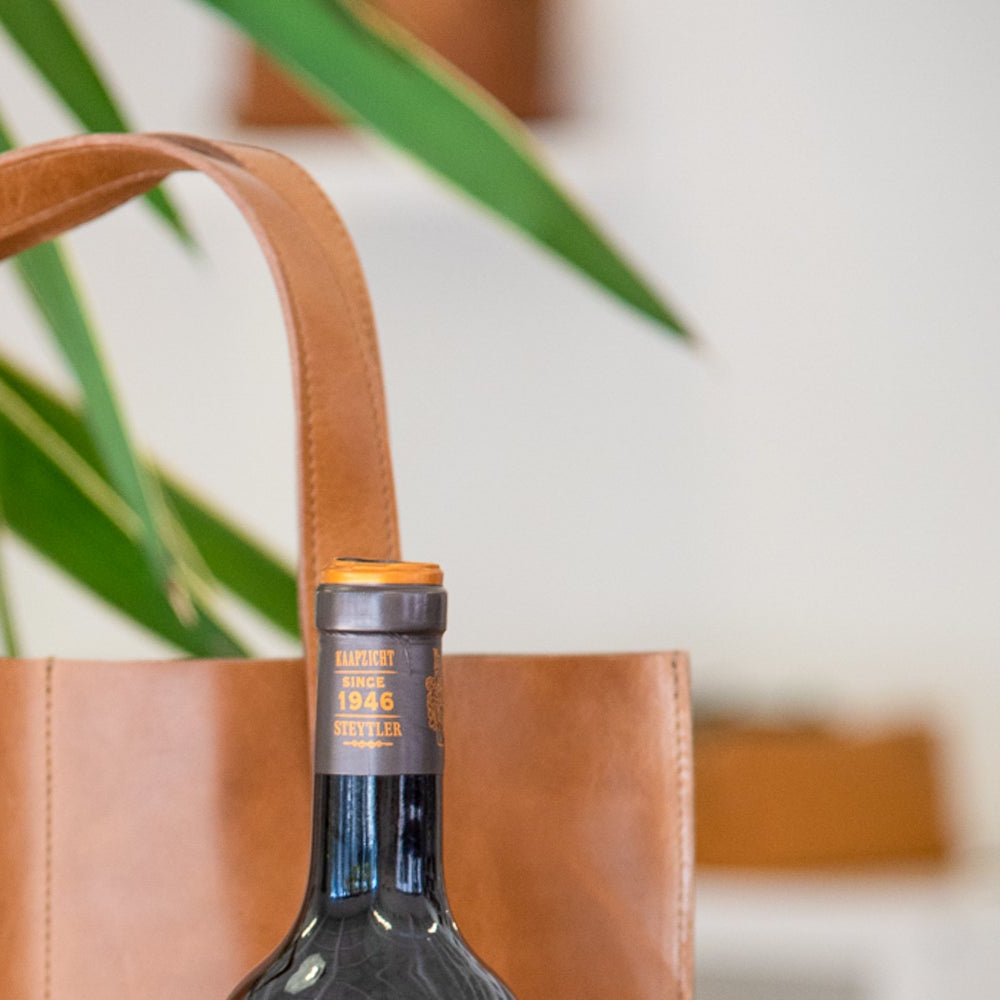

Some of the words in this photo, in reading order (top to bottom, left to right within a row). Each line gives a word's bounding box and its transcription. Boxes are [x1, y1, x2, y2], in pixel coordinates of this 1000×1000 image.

[335, 650, 395, 666] KAAPZICHT
[342, 675, 386, 688] SINCE
[338, 691, 394, 711] 1946
[334, 720, 402, 736] STEYTLER
